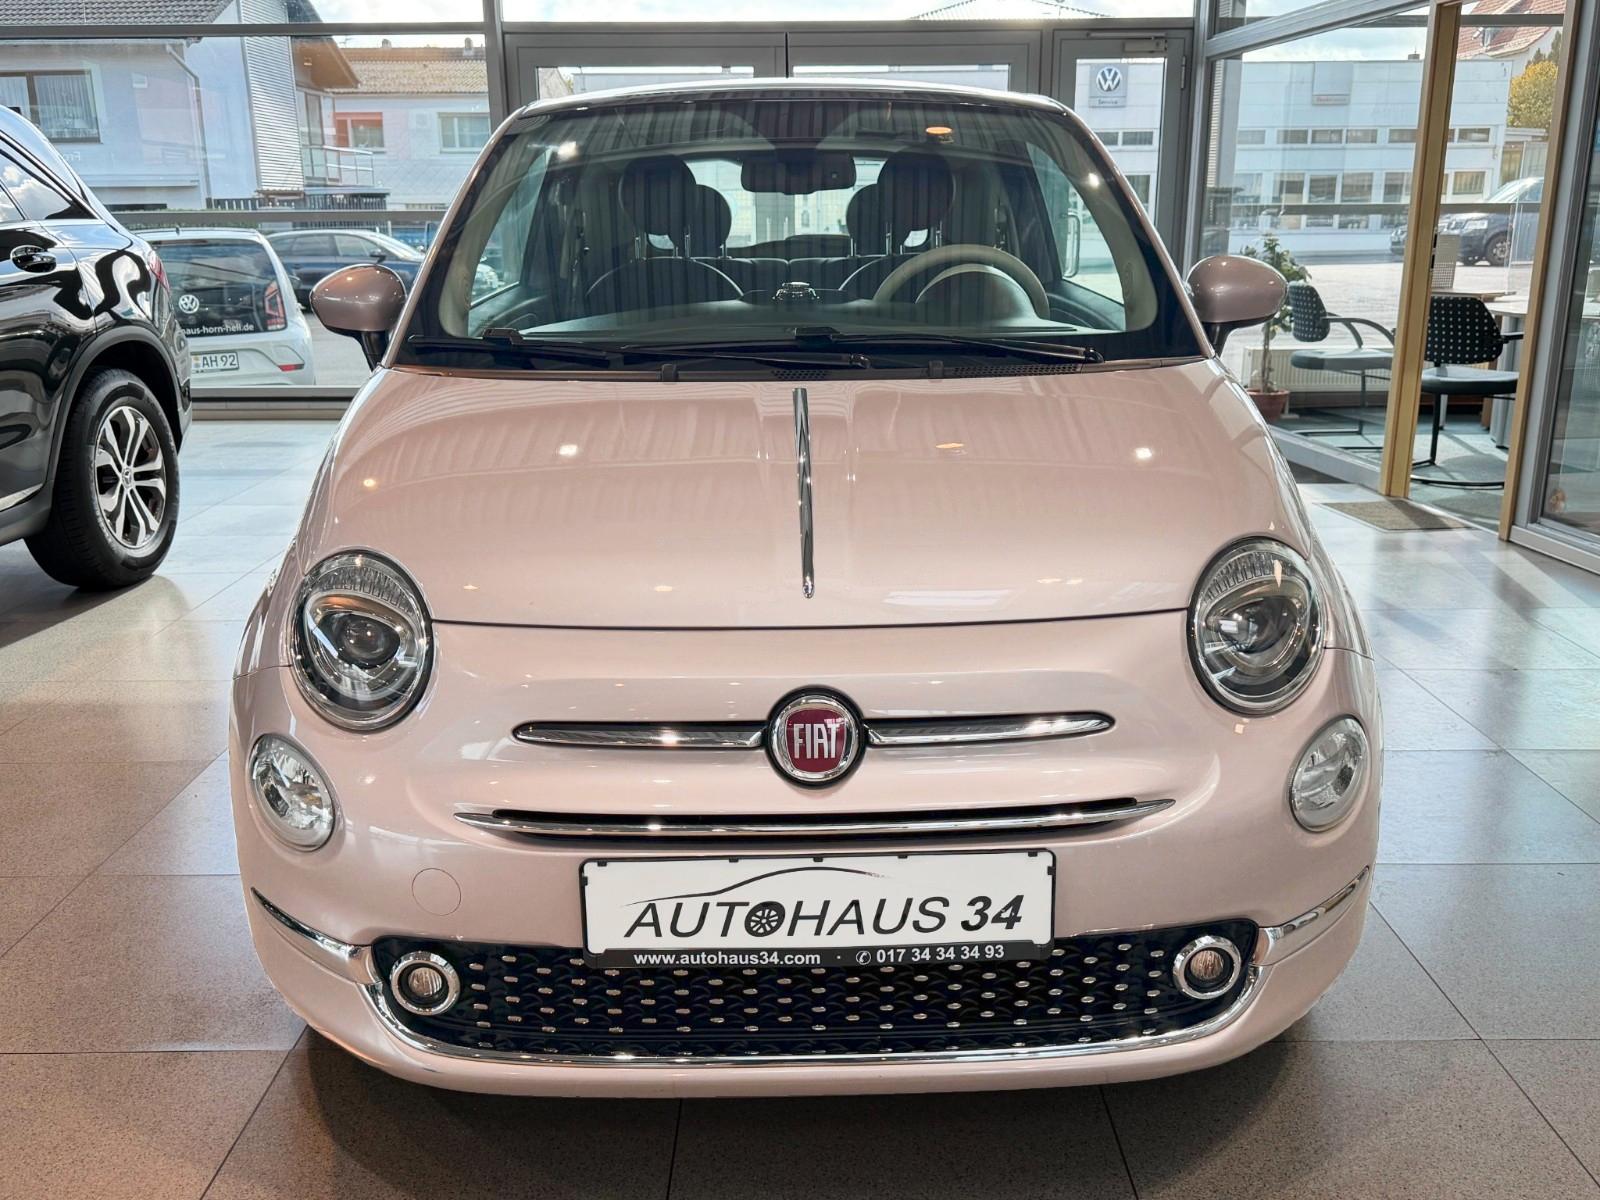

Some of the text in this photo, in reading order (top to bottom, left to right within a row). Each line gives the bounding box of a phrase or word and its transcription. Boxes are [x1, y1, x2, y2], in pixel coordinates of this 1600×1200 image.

[202, 354, 238, 368] AH 92
[793, 723, 838, 759] FIAT
[623, 894, 1024, 938] AUTOHAUS 34
[633, 944, 1005, 965] www.autohaus34.com 017 34 34 34 93
